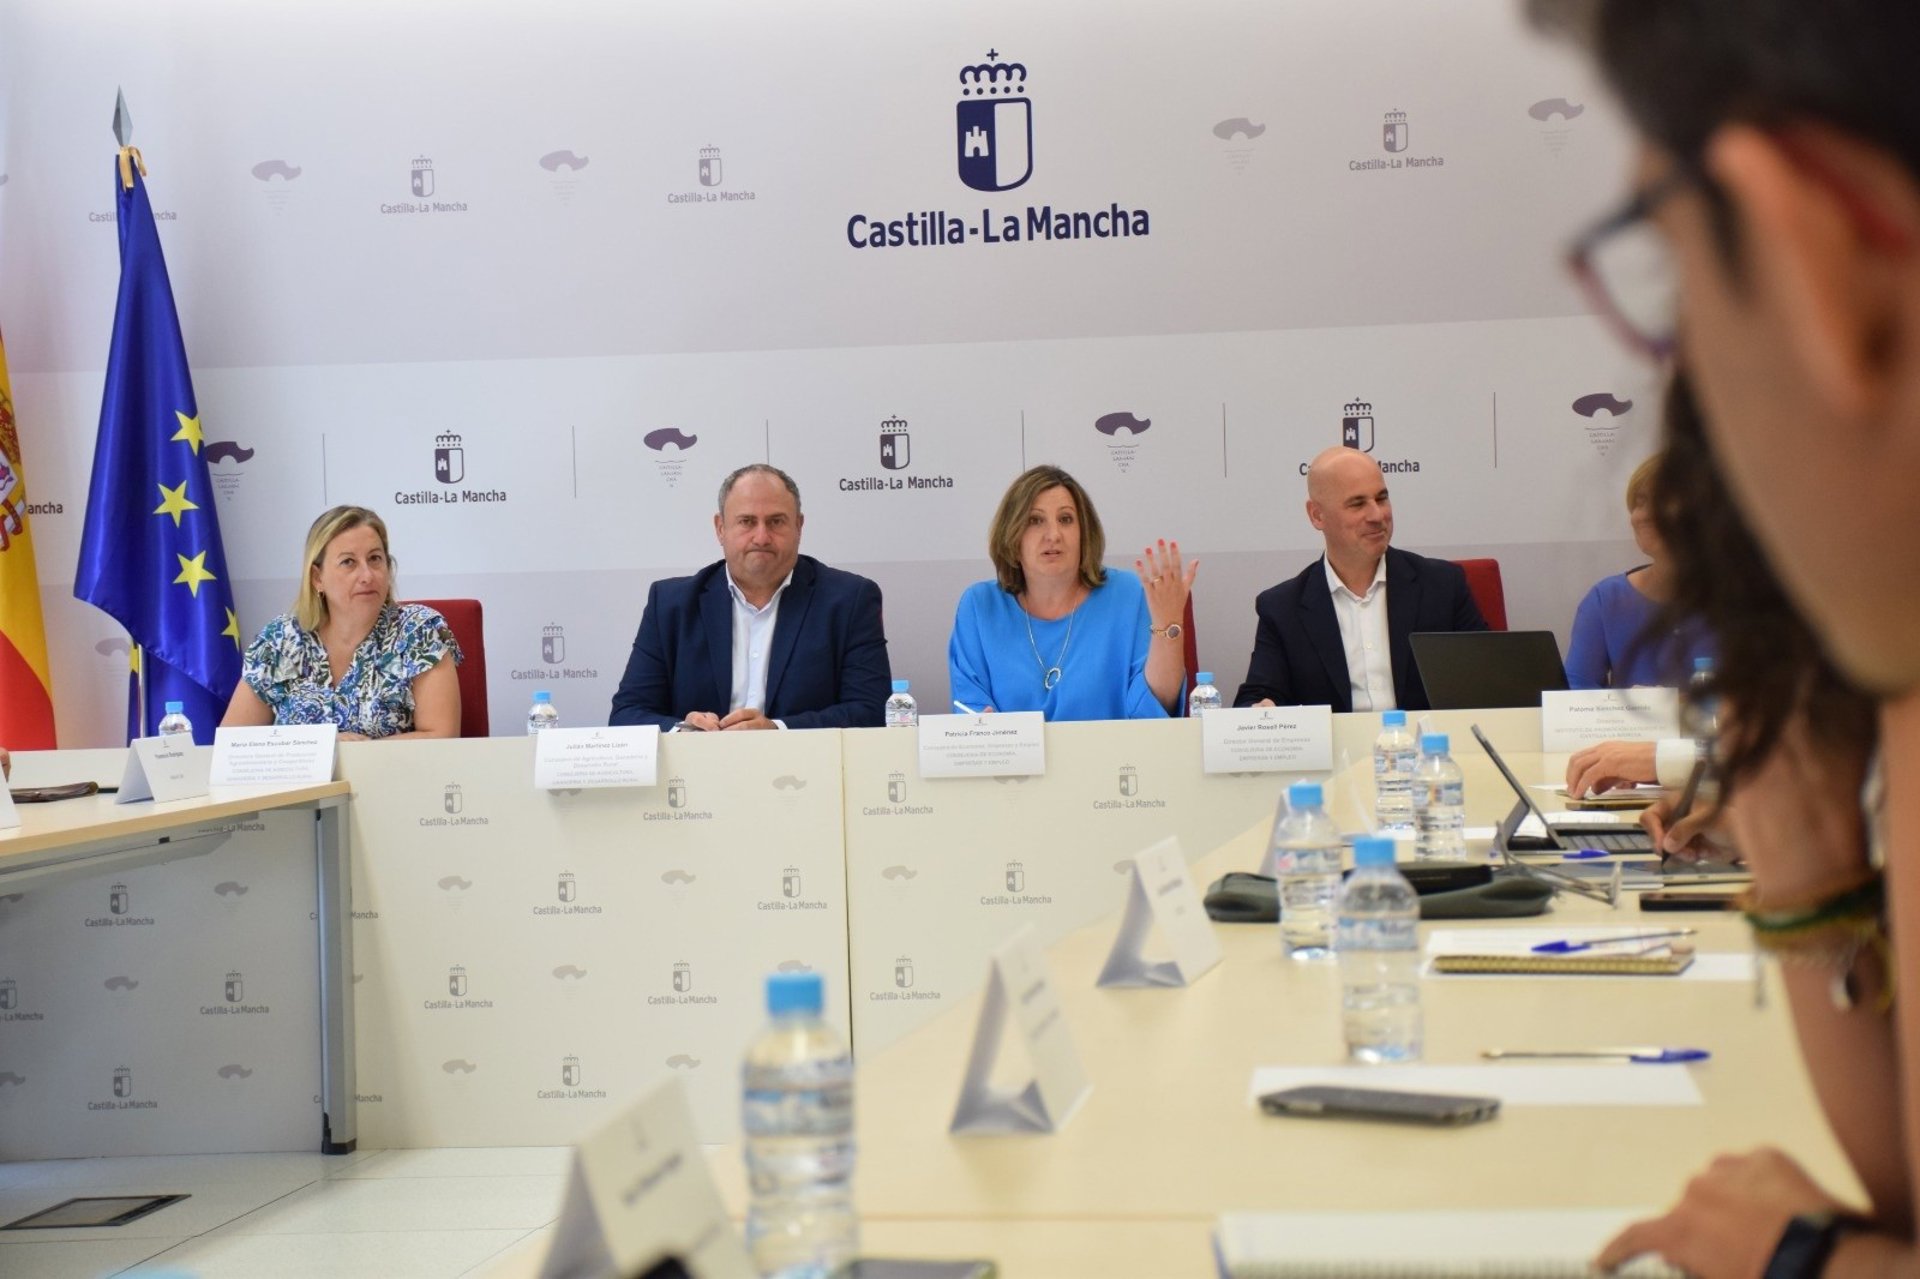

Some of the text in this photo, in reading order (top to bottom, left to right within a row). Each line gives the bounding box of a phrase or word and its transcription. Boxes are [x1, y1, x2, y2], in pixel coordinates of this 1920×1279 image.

[1349, 156, 1444, 171] Castilla-La Mancha
[668, 191, 755, 203] Castilla-La Mancha
[381, 202, 467, 214] Castilla-La Mancha
[1027, 203, 1149, 241] Mancha
[1378, 459, 1420, 473] ancha
[839, 476, 953, 491] Castilla-La Mancha
[395, 490, 506, 504] Castilla-La Mancha
[27, 502, 64, 515] ancha
[511, 668, 597, 679] Castilla-La Mancha
[1135, 799, 1166, 808] Mancha
[643, 811, 712, 820] Castilla-La Mancha
[863, 805, 933, 816] Castilla-La Mancha
[420, 816, 489, 826] Castilla-La Mancha
[757, 901, 827, 910] Castilla-La Mancha
[981, 896, 1051, 905] Castilla-La Mancha
[533, 905, 602, 915] Castilla-La Mancha
[85, 917, 155, 927] Castilla-La Mancha
[647, 995, 717, 1005] Castilla-La Mancha
[869, 991, 940, 1000] Castilla-La Mancha
[424, 999, 493, 1009] Castilla-La Mancha
[200, 1005, 269, 1015] Castilla-La Mancha
[15, 1013, 43, 1021] Mancha
[537, 1089, 606, 1098] Castilla-La Mancha
[88, 1100, 157, 1110] Castilla-La Mancha
